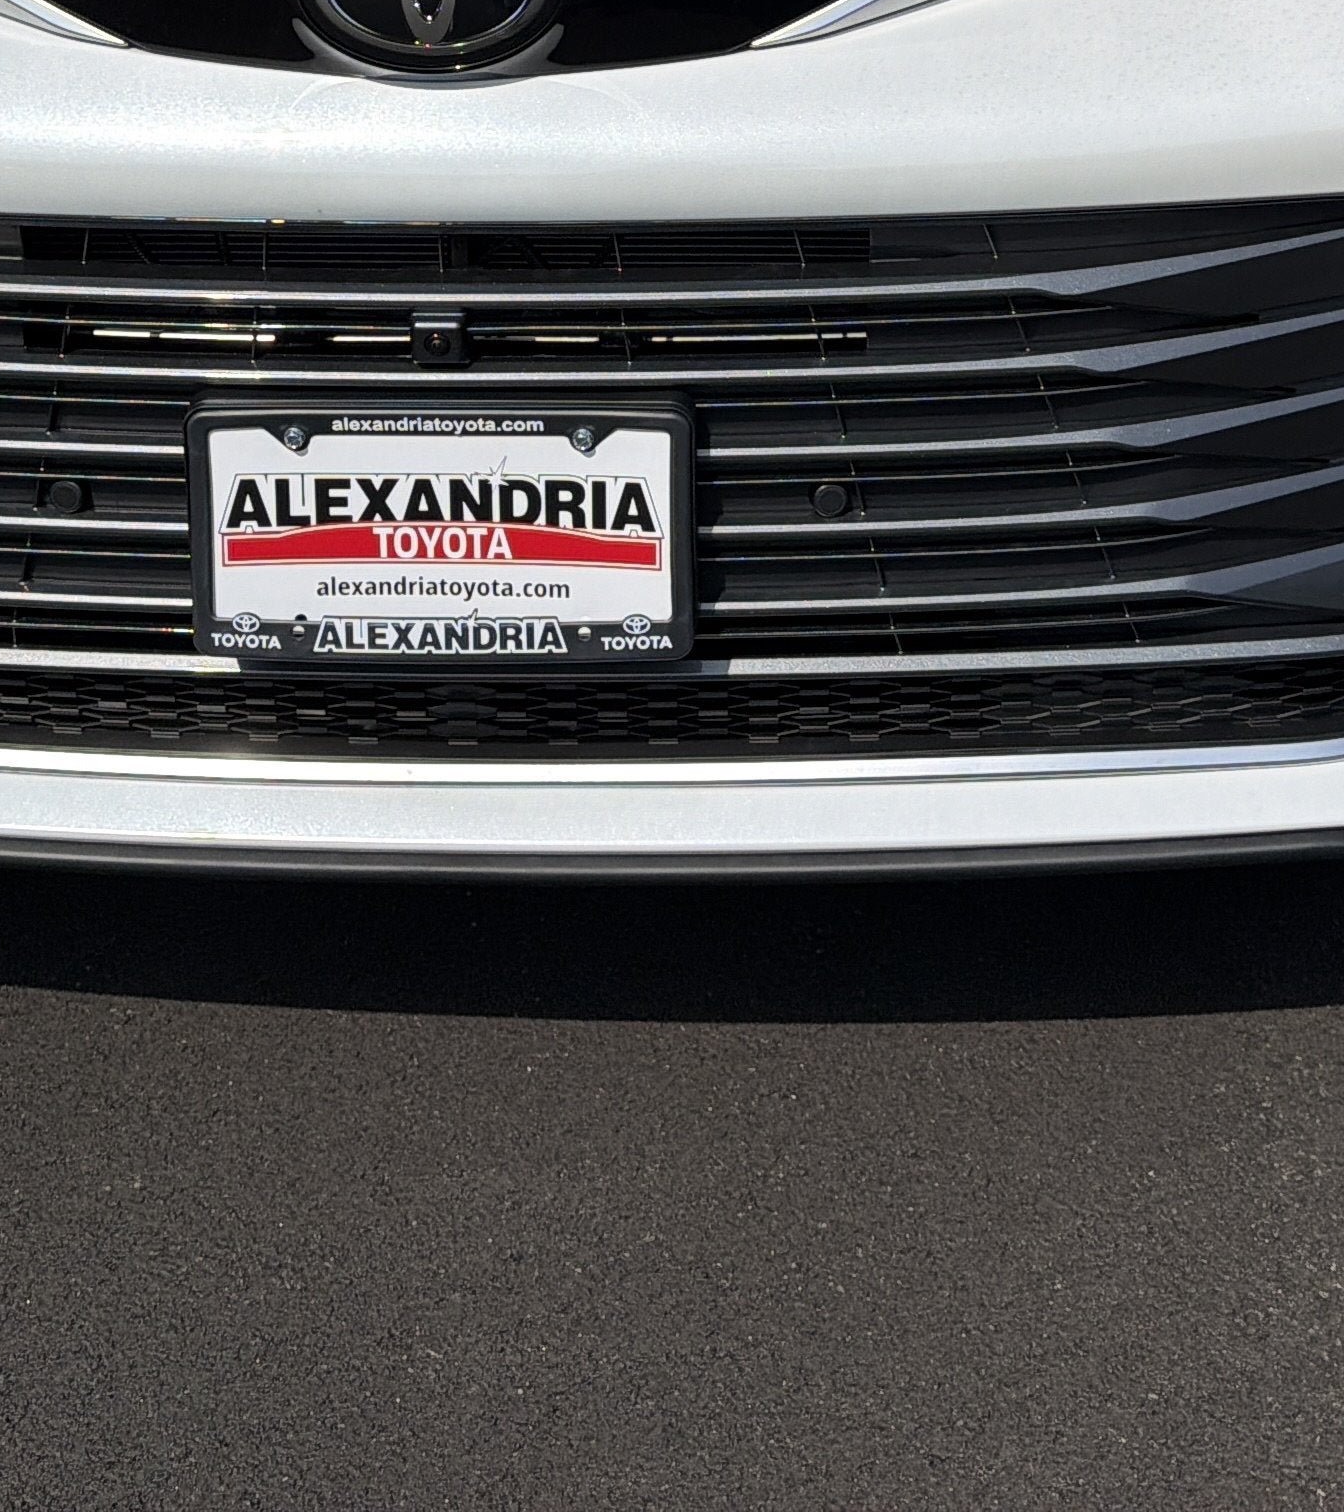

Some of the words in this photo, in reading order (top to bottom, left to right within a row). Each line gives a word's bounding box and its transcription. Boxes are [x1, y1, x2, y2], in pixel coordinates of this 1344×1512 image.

[331, 417, 545, 434] alexandriatoyota.com
[224, 476, 658, 533] ALEXANDRIA
[372, 526, 513, 559] TOYOTA
[316, 576, 571, 601] alexandriatoyota.com
[210, 632, 283, 650] TOYOTA
[316, 619, 566, 652] ALEXANDRIA
[600, 635, 674, 651] TOYOTA
